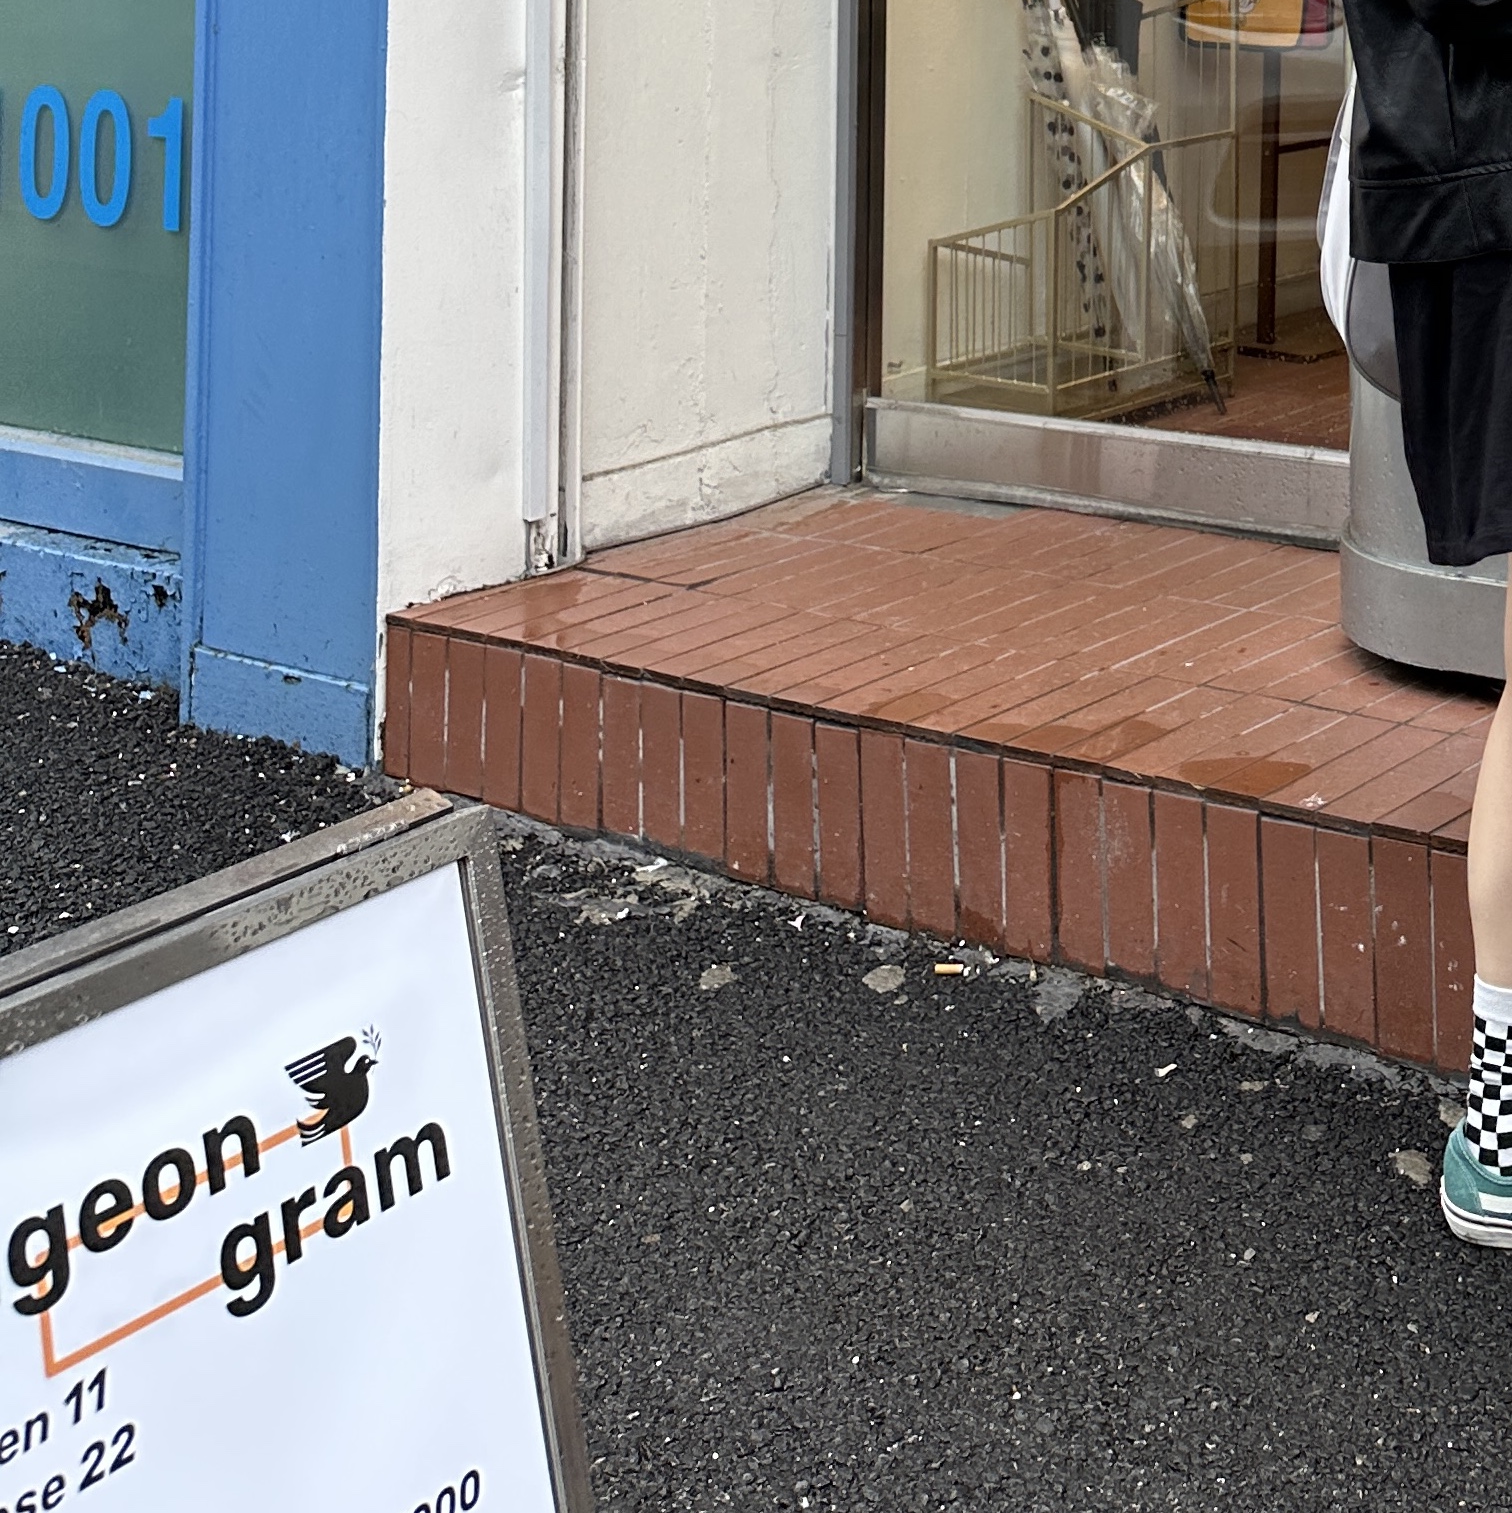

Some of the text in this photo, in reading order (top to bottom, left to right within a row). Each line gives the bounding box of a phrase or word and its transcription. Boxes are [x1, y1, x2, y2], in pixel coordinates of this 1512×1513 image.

[19, 84, 183, 232] 001
[7, 1114, 260, 1316] geon
[220, 1121, 451, 1318] gram
[63, 1365, 108, 1426] 11
[0, 1423, 136, 1513] se 22
[413, 1469, 480, 1513] 00
